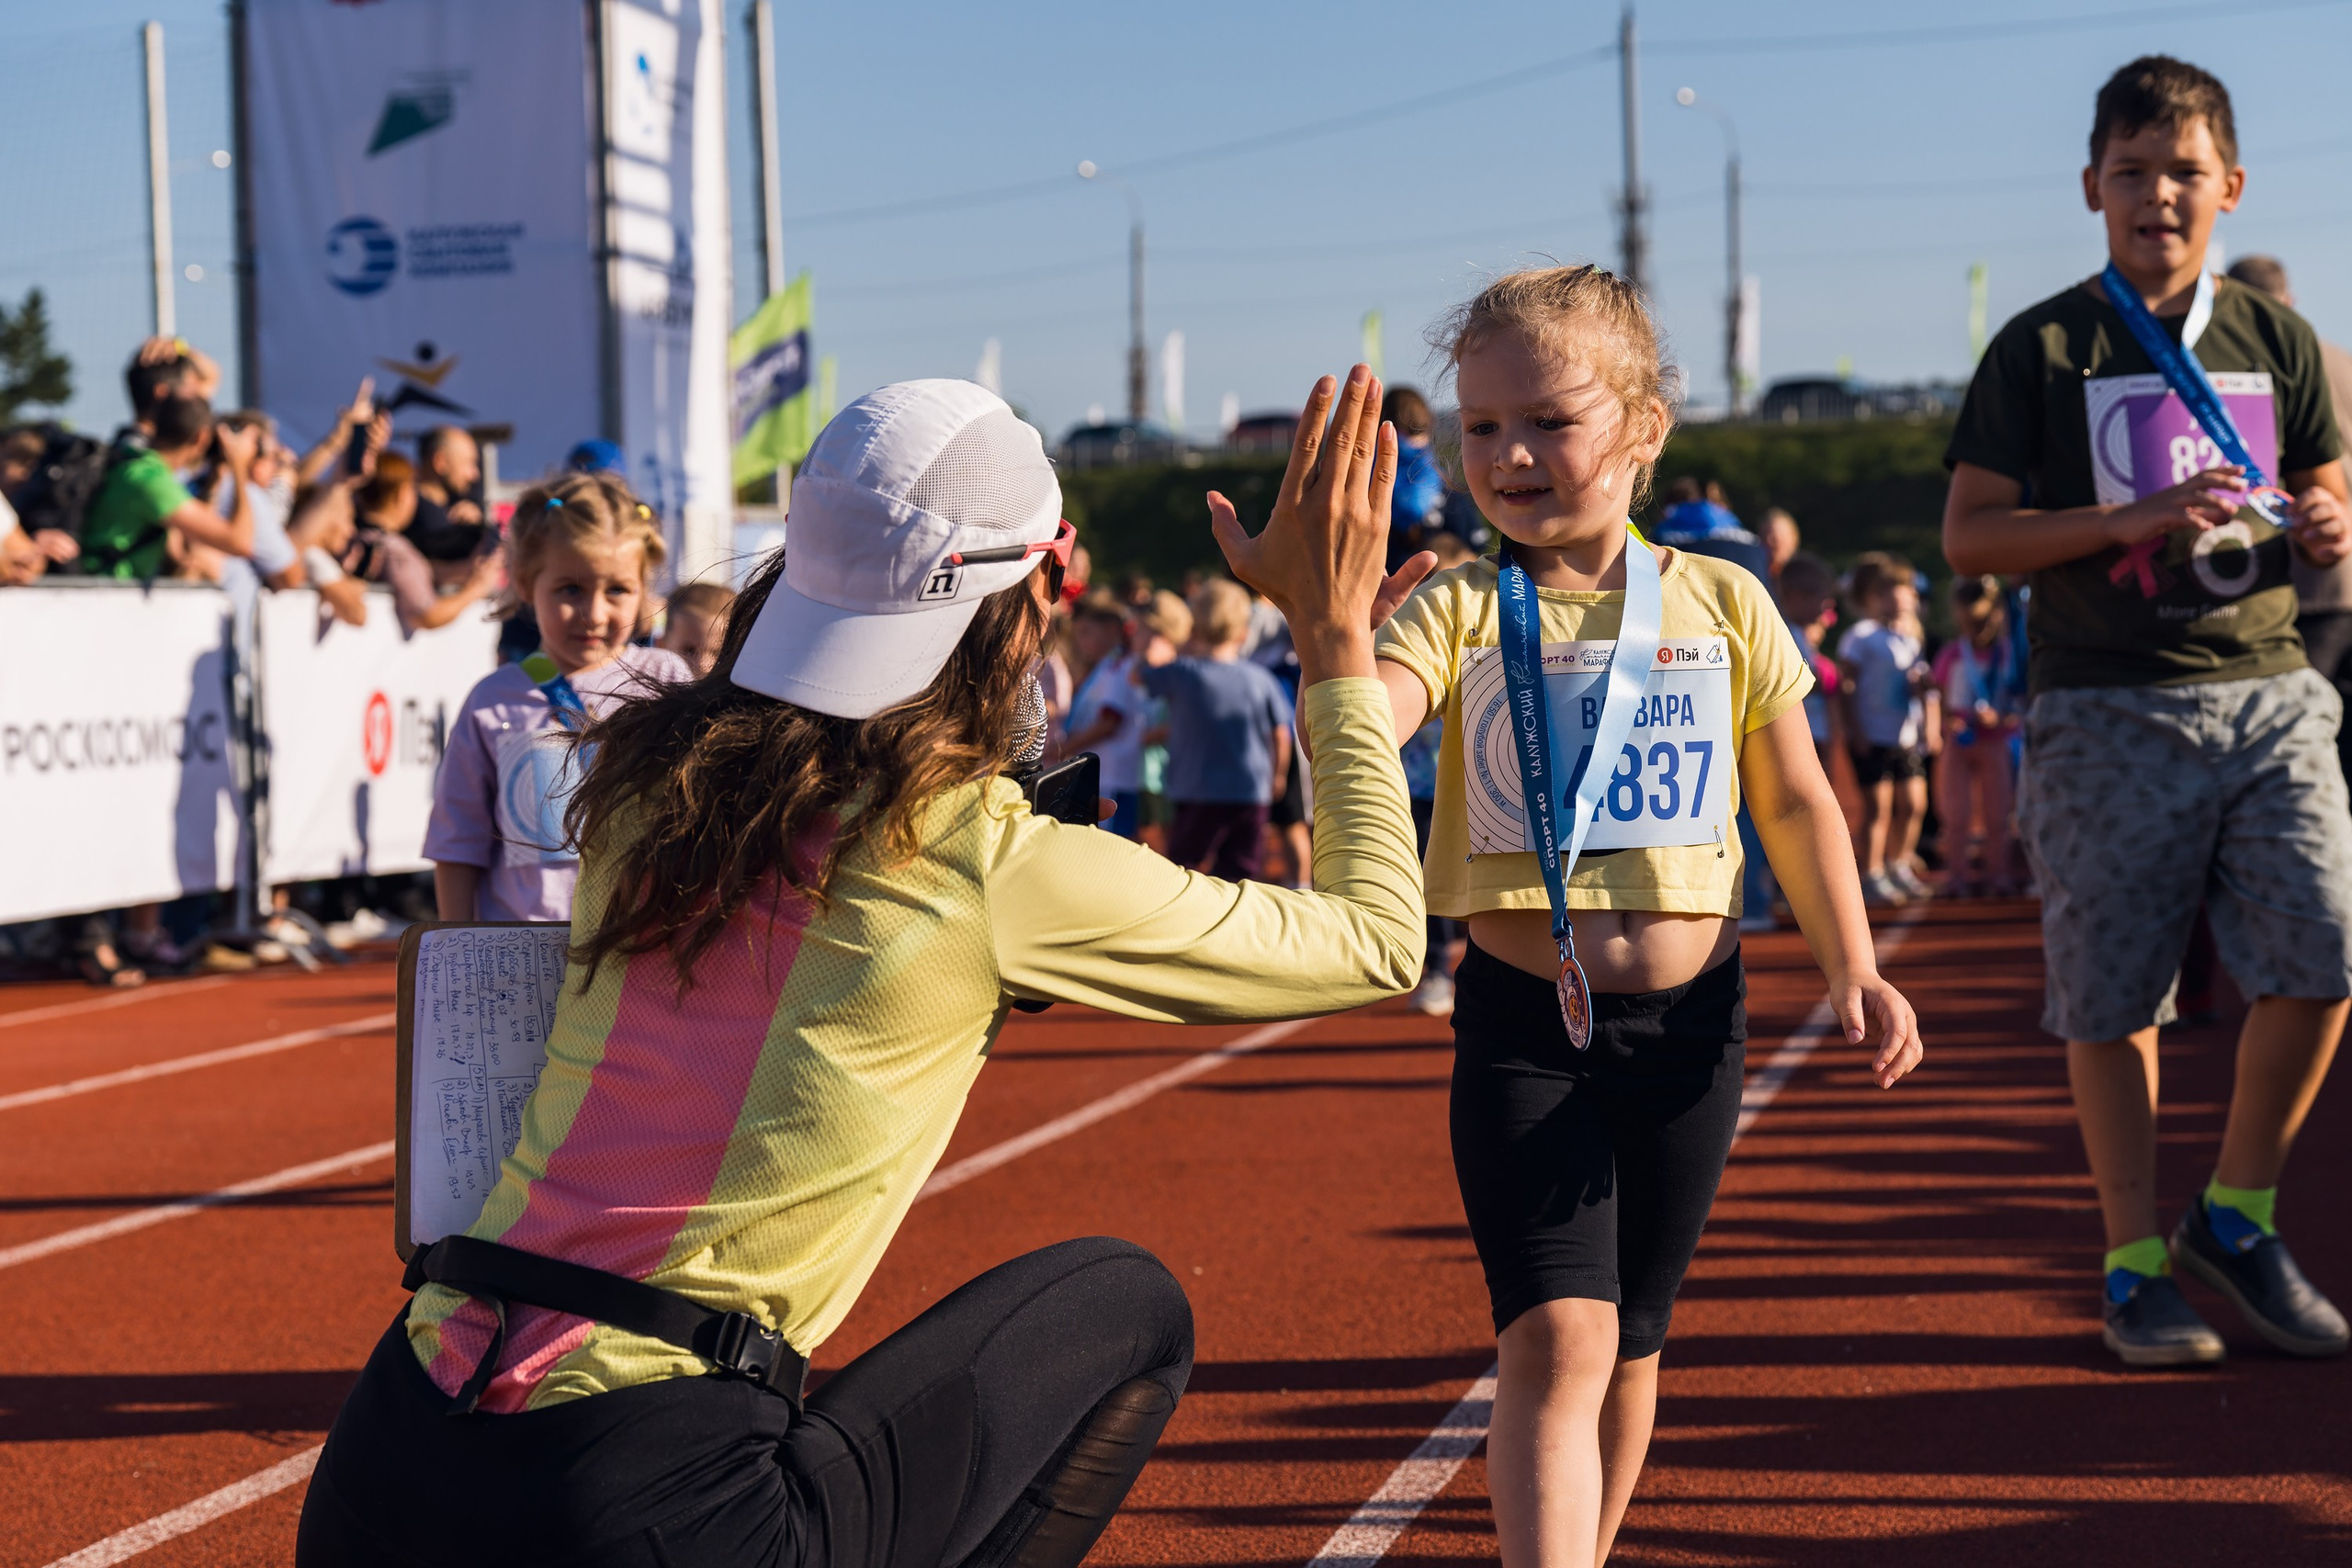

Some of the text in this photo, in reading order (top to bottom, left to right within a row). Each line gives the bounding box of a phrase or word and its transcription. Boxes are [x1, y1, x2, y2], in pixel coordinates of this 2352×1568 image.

[1510, 554, 1526, 601] МАРАФ
[1562, 655, 1575, 663] 40
[1677, 648, 1699, 661] Пэй
[1487, 698, 1502, 716] 16:50
[1476, 720, 1487, 749] голубой
[1517, 688, 1543, 778] КАЛУЖСКИЙ
[1476, 750, 1486, 769] забег
[1492, 787, 1503, 801] 300
[1536, 792, 1555, 869] СПОРТ 40
